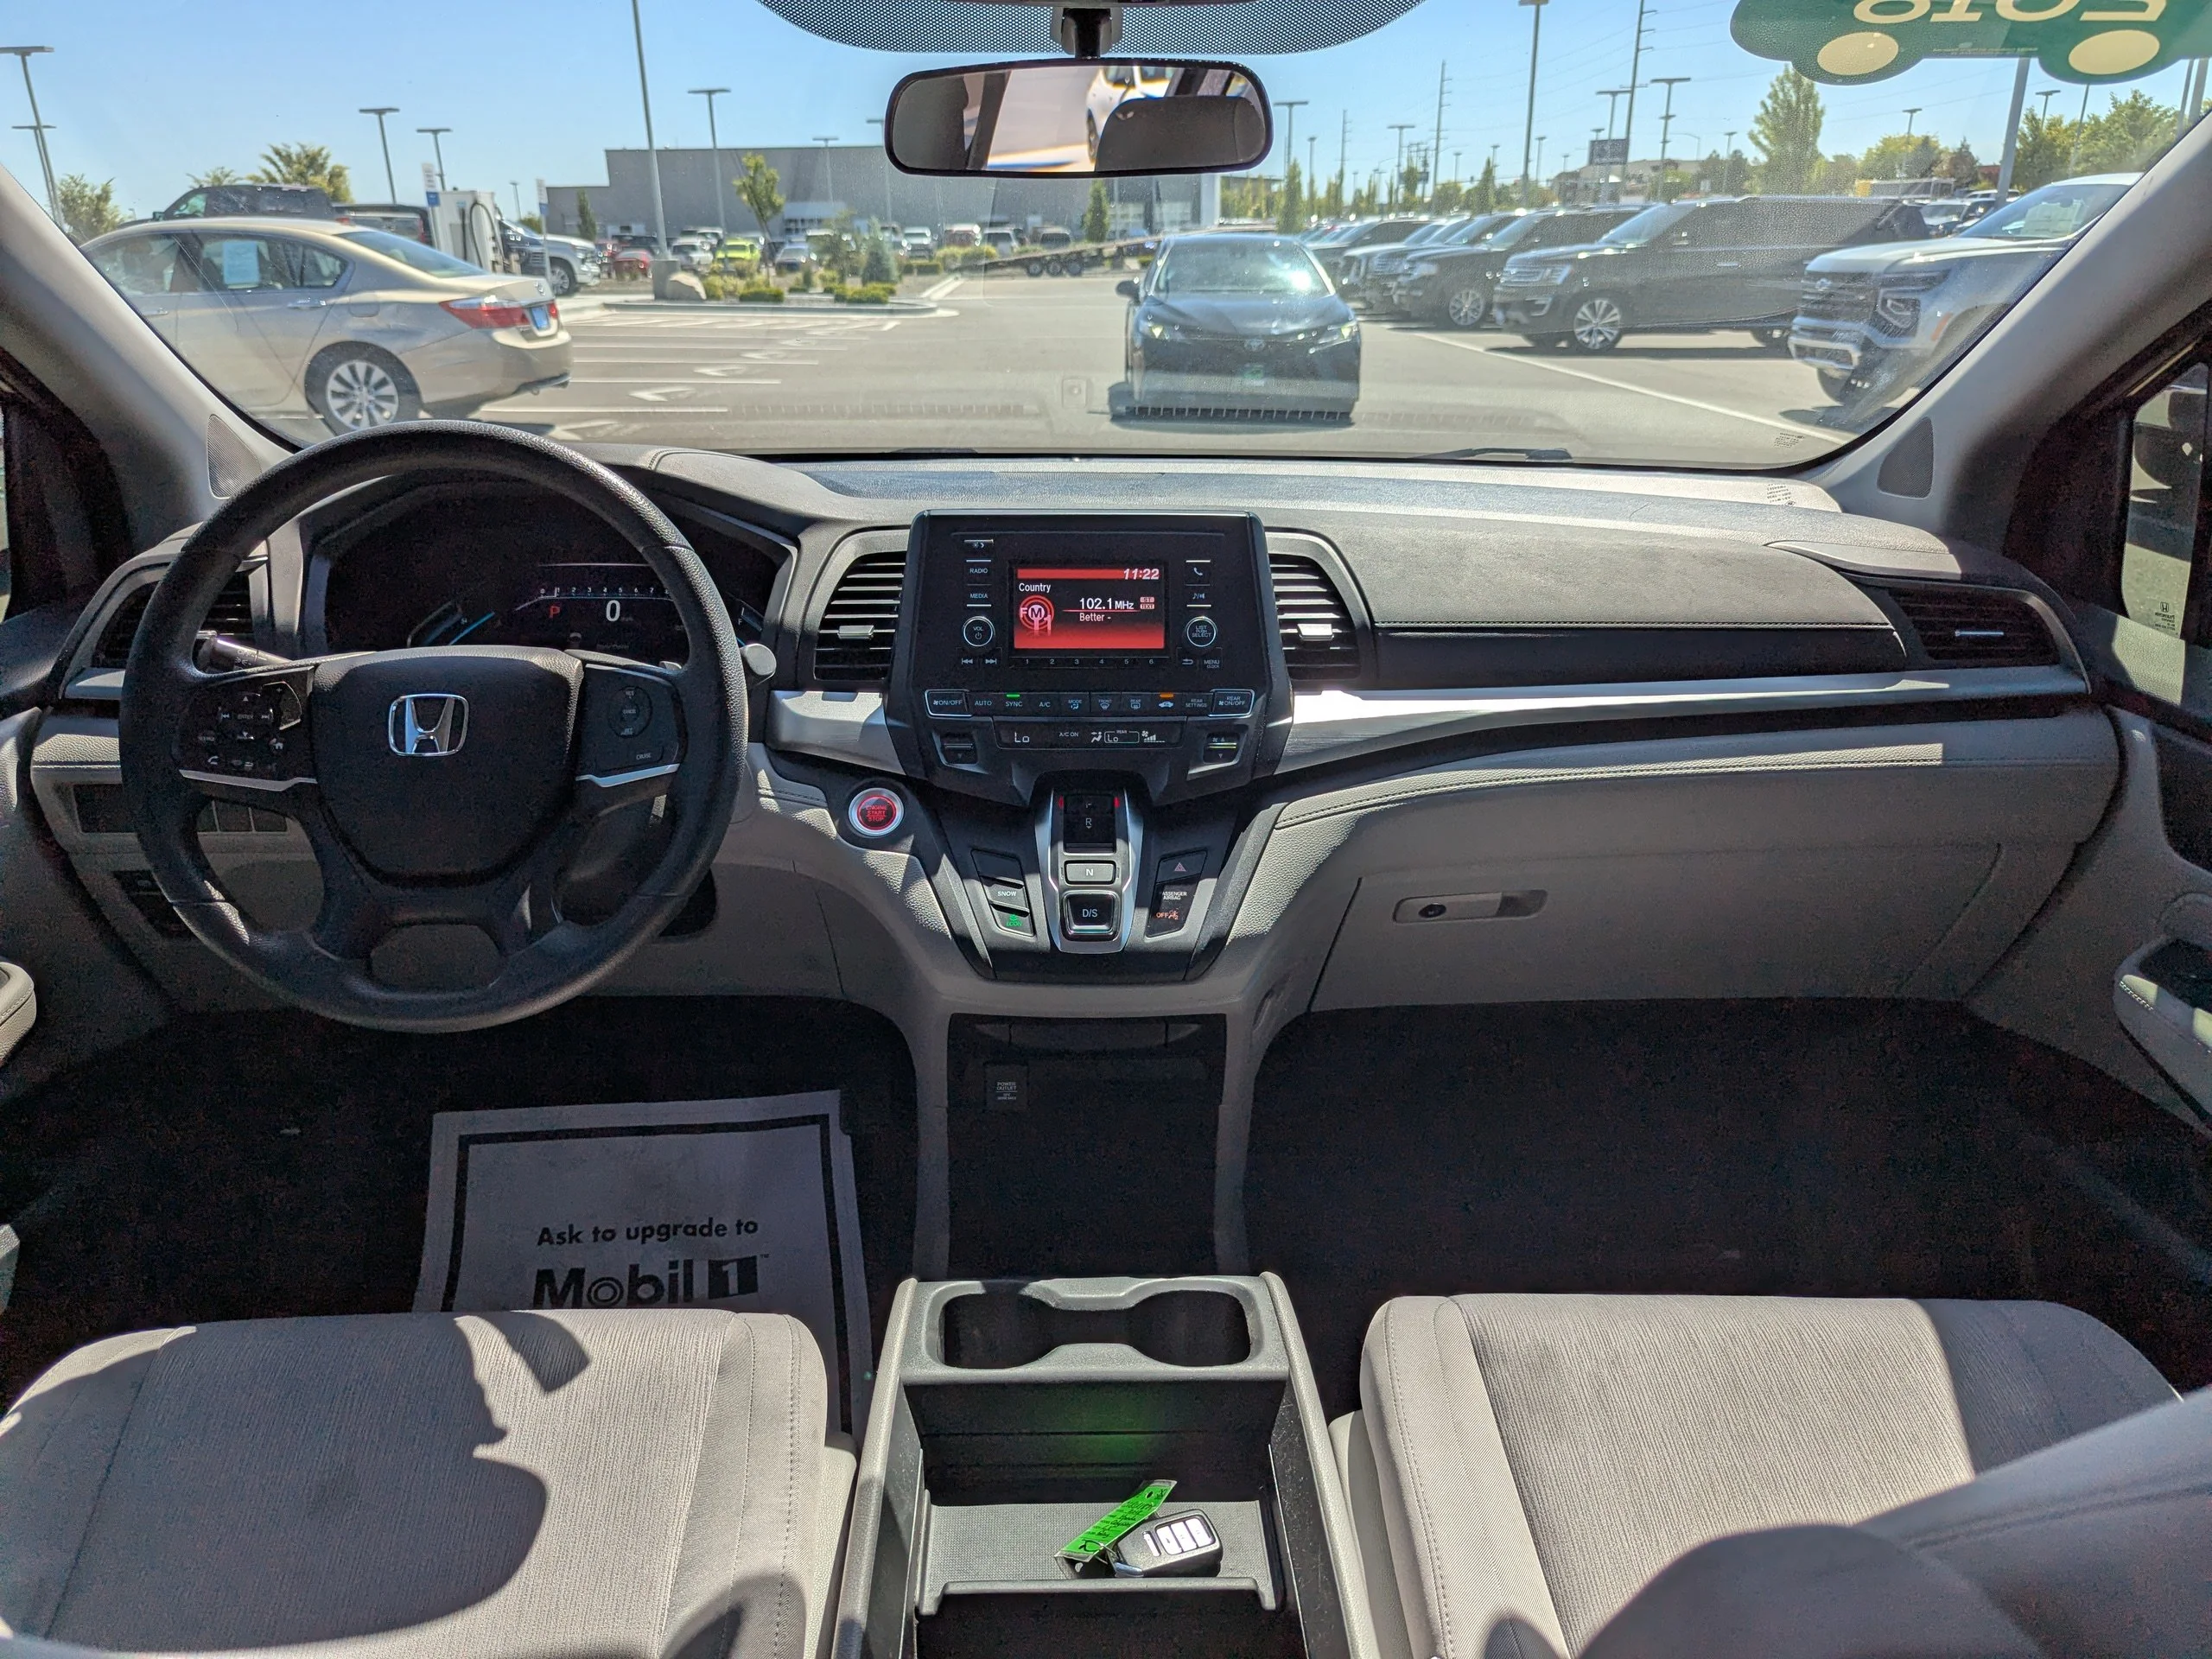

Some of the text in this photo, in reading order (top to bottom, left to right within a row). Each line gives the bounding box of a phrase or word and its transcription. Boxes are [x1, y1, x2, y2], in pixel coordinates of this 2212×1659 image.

[1123, 568, 1160, 580] 11:22
[1019, 582, 1052, 594] Country
[1079, 598, 1135, 610] 102.1 MHz
[606, 600, 621, 622] 0
[1079, 613, 1104, 621] Better
[1082, 909, 1098, 918] D/S
[537, 1217, 759, 1246] Ask to upgrade to
[532, 1259, 694, 1310] Mobil
